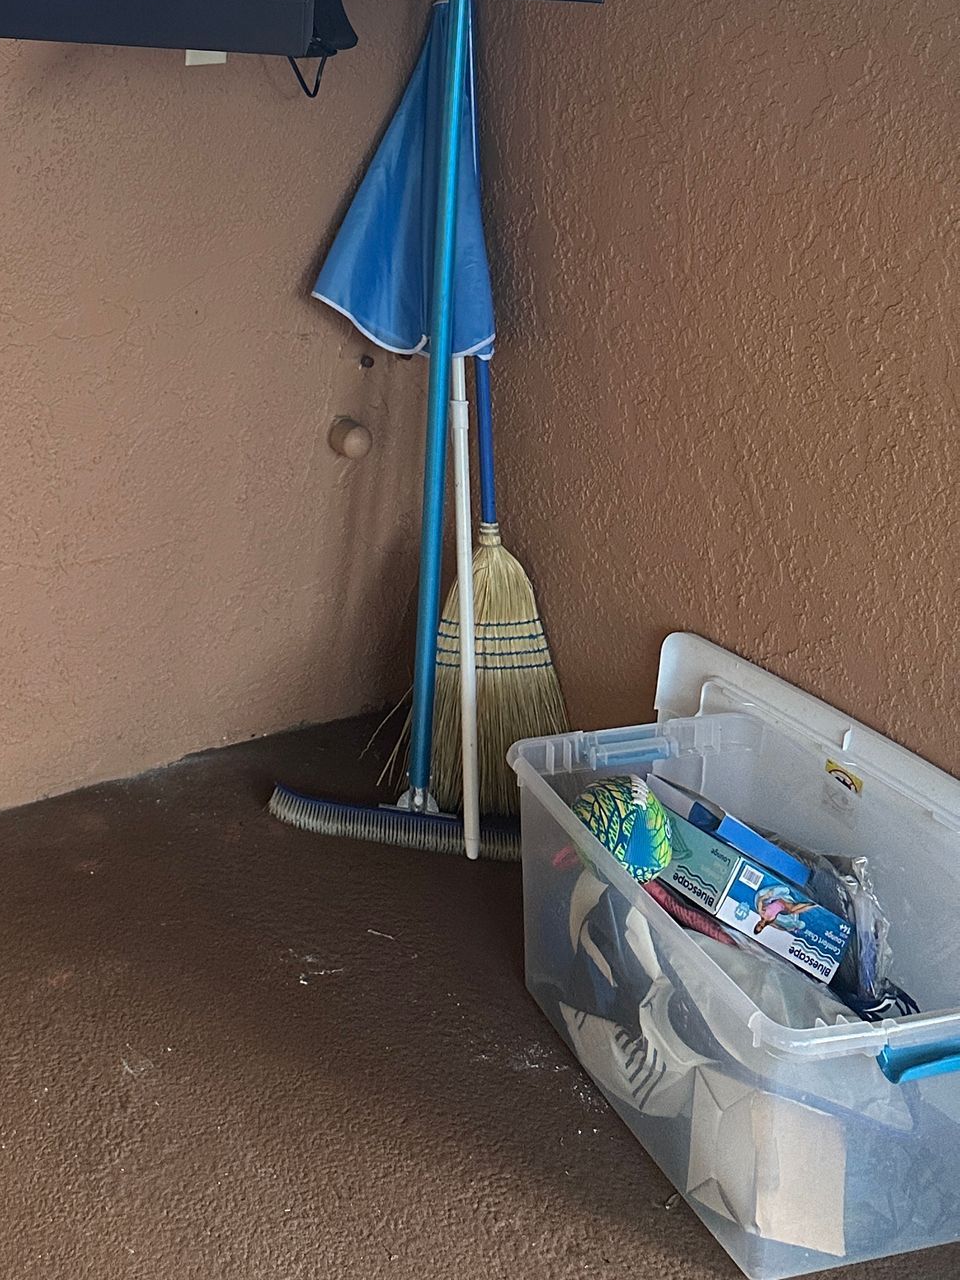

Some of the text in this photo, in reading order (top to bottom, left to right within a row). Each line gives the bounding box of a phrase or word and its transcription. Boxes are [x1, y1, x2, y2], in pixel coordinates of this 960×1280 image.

[711, 848, 731, 865] Lounge
[672, 872, 715, 908] Bluescape
[825, 930, 845, 948] Lounge
[840, 924, 850, 934] 14+
[804, 929, 840, 955] Comfort Chair
[788, 946, 832, 977] Bluescape
